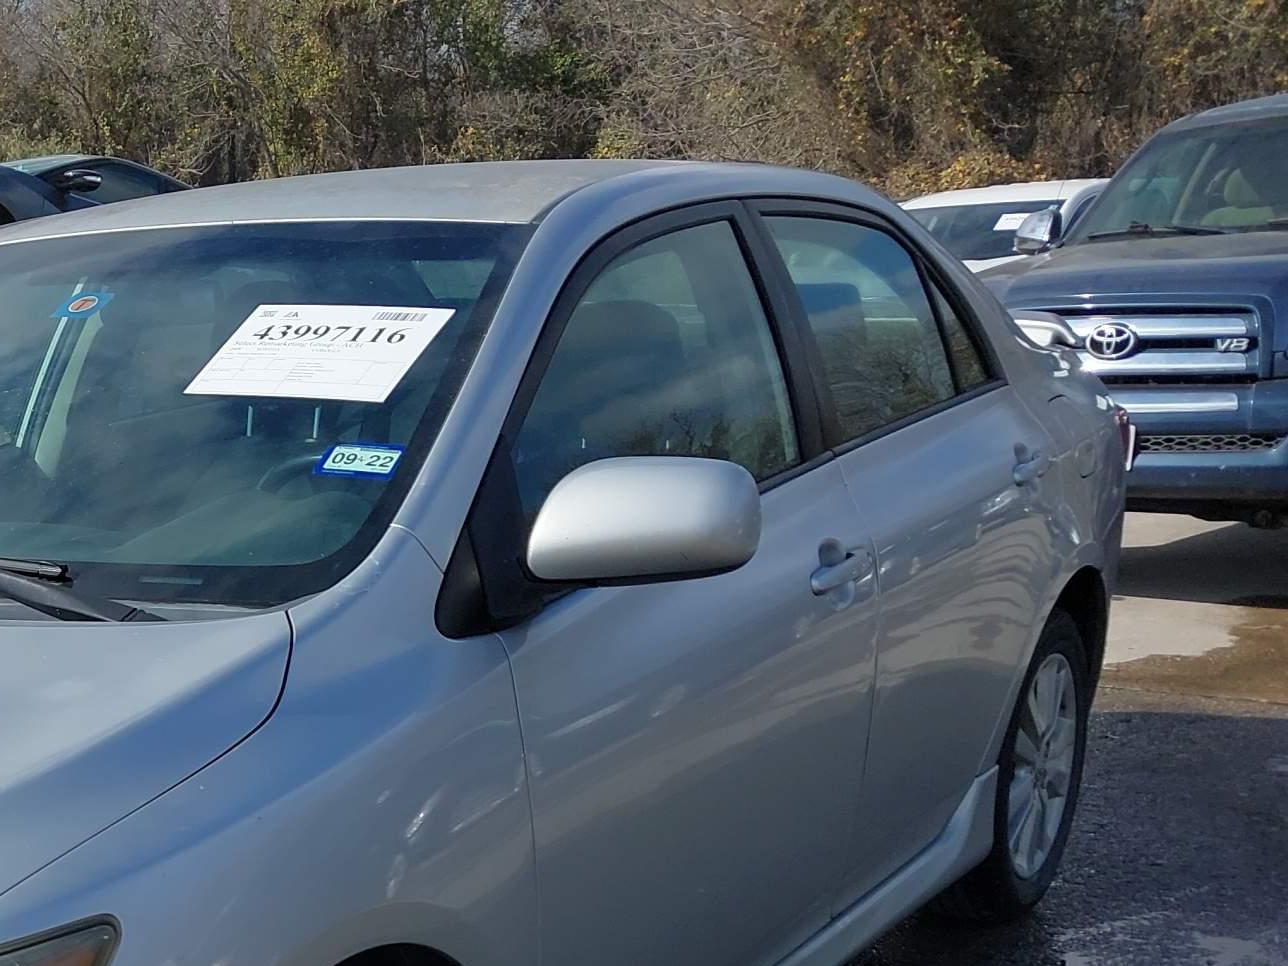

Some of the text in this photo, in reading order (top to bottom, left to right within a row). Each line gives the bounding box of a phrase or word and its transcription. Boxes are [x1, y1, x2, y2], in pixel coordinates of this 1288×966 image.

[253, 324, 411, 344] 43997116
[1216, 338, 1250, 352] V8
[332, 452, 394, 468] 09 22
